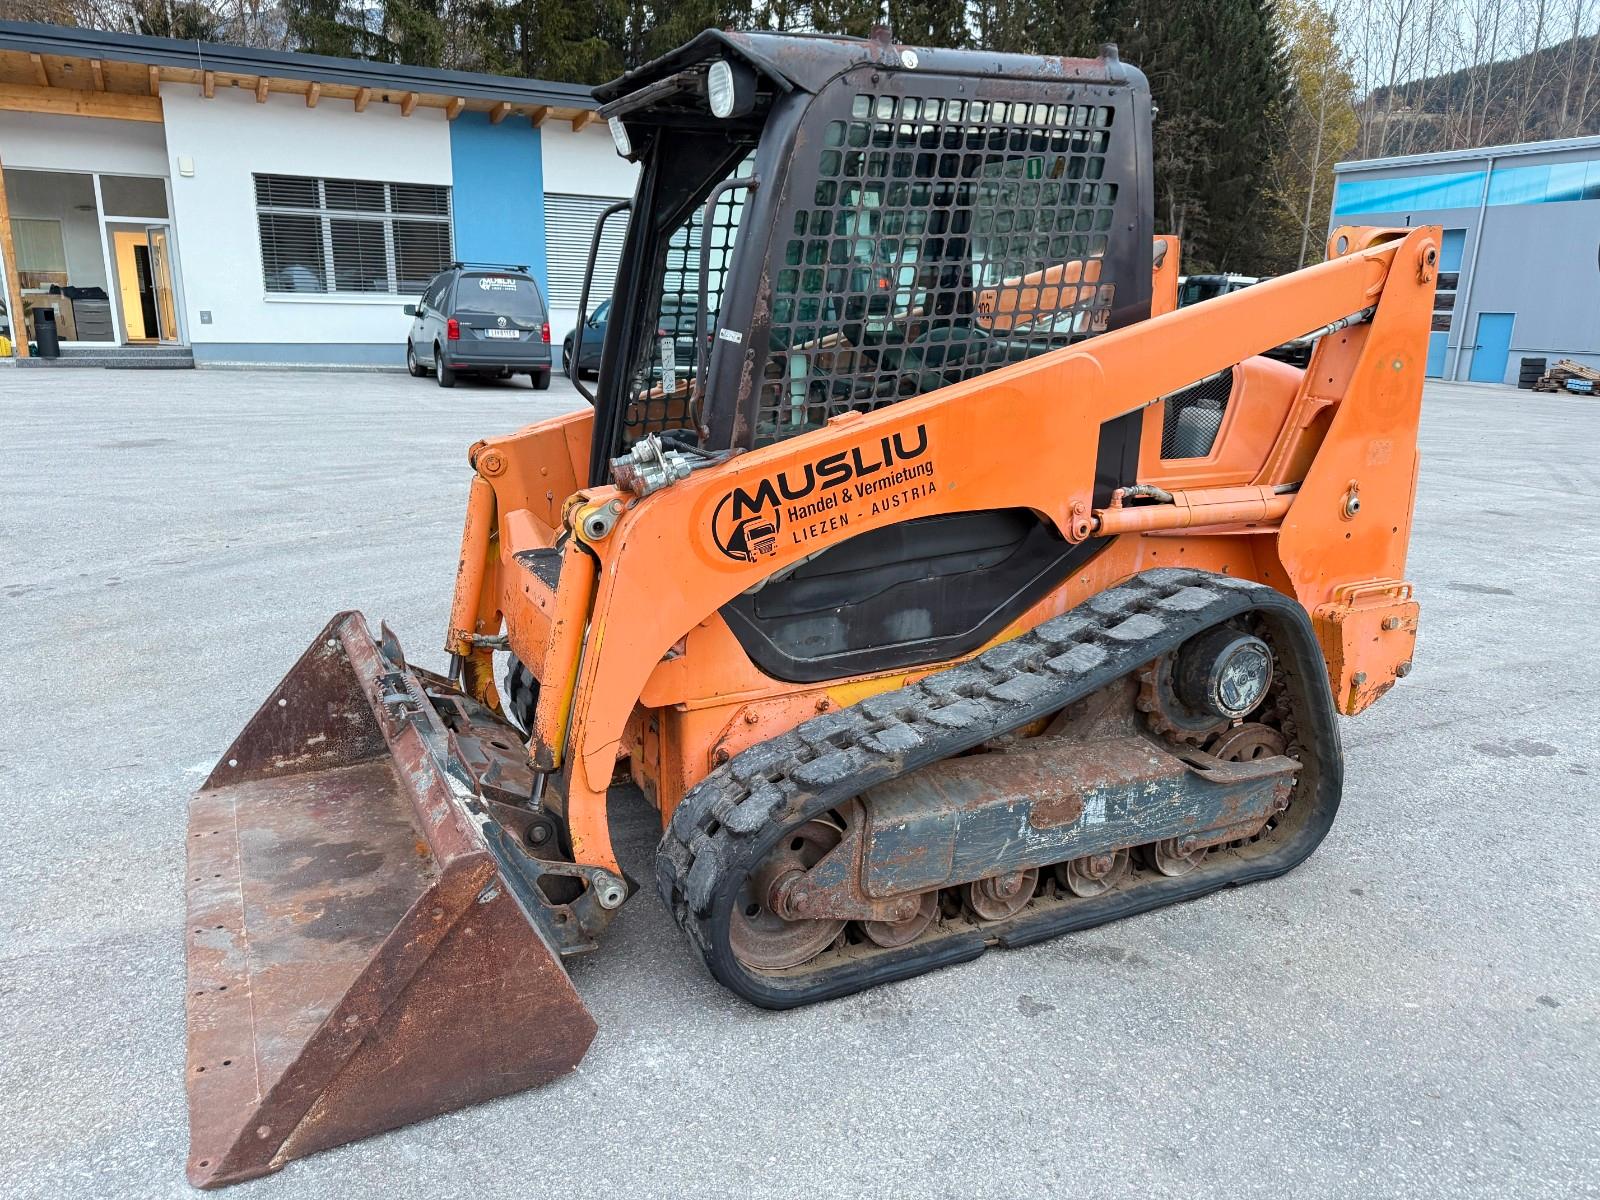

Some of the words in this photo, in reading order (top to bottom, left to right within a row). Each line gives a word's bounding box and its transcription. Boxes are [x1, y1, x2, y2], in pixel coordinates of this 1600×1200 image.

[732, 424, 929, 521] MUSLIU
[788, 492, 838, 522] Handel
[841, 488, 853, 503] &
[854, 460, 934, 499] Vermietung
[793, 512, 850, 544] LIEZEN
[871, 481, 938, 516] AUSTRIA
